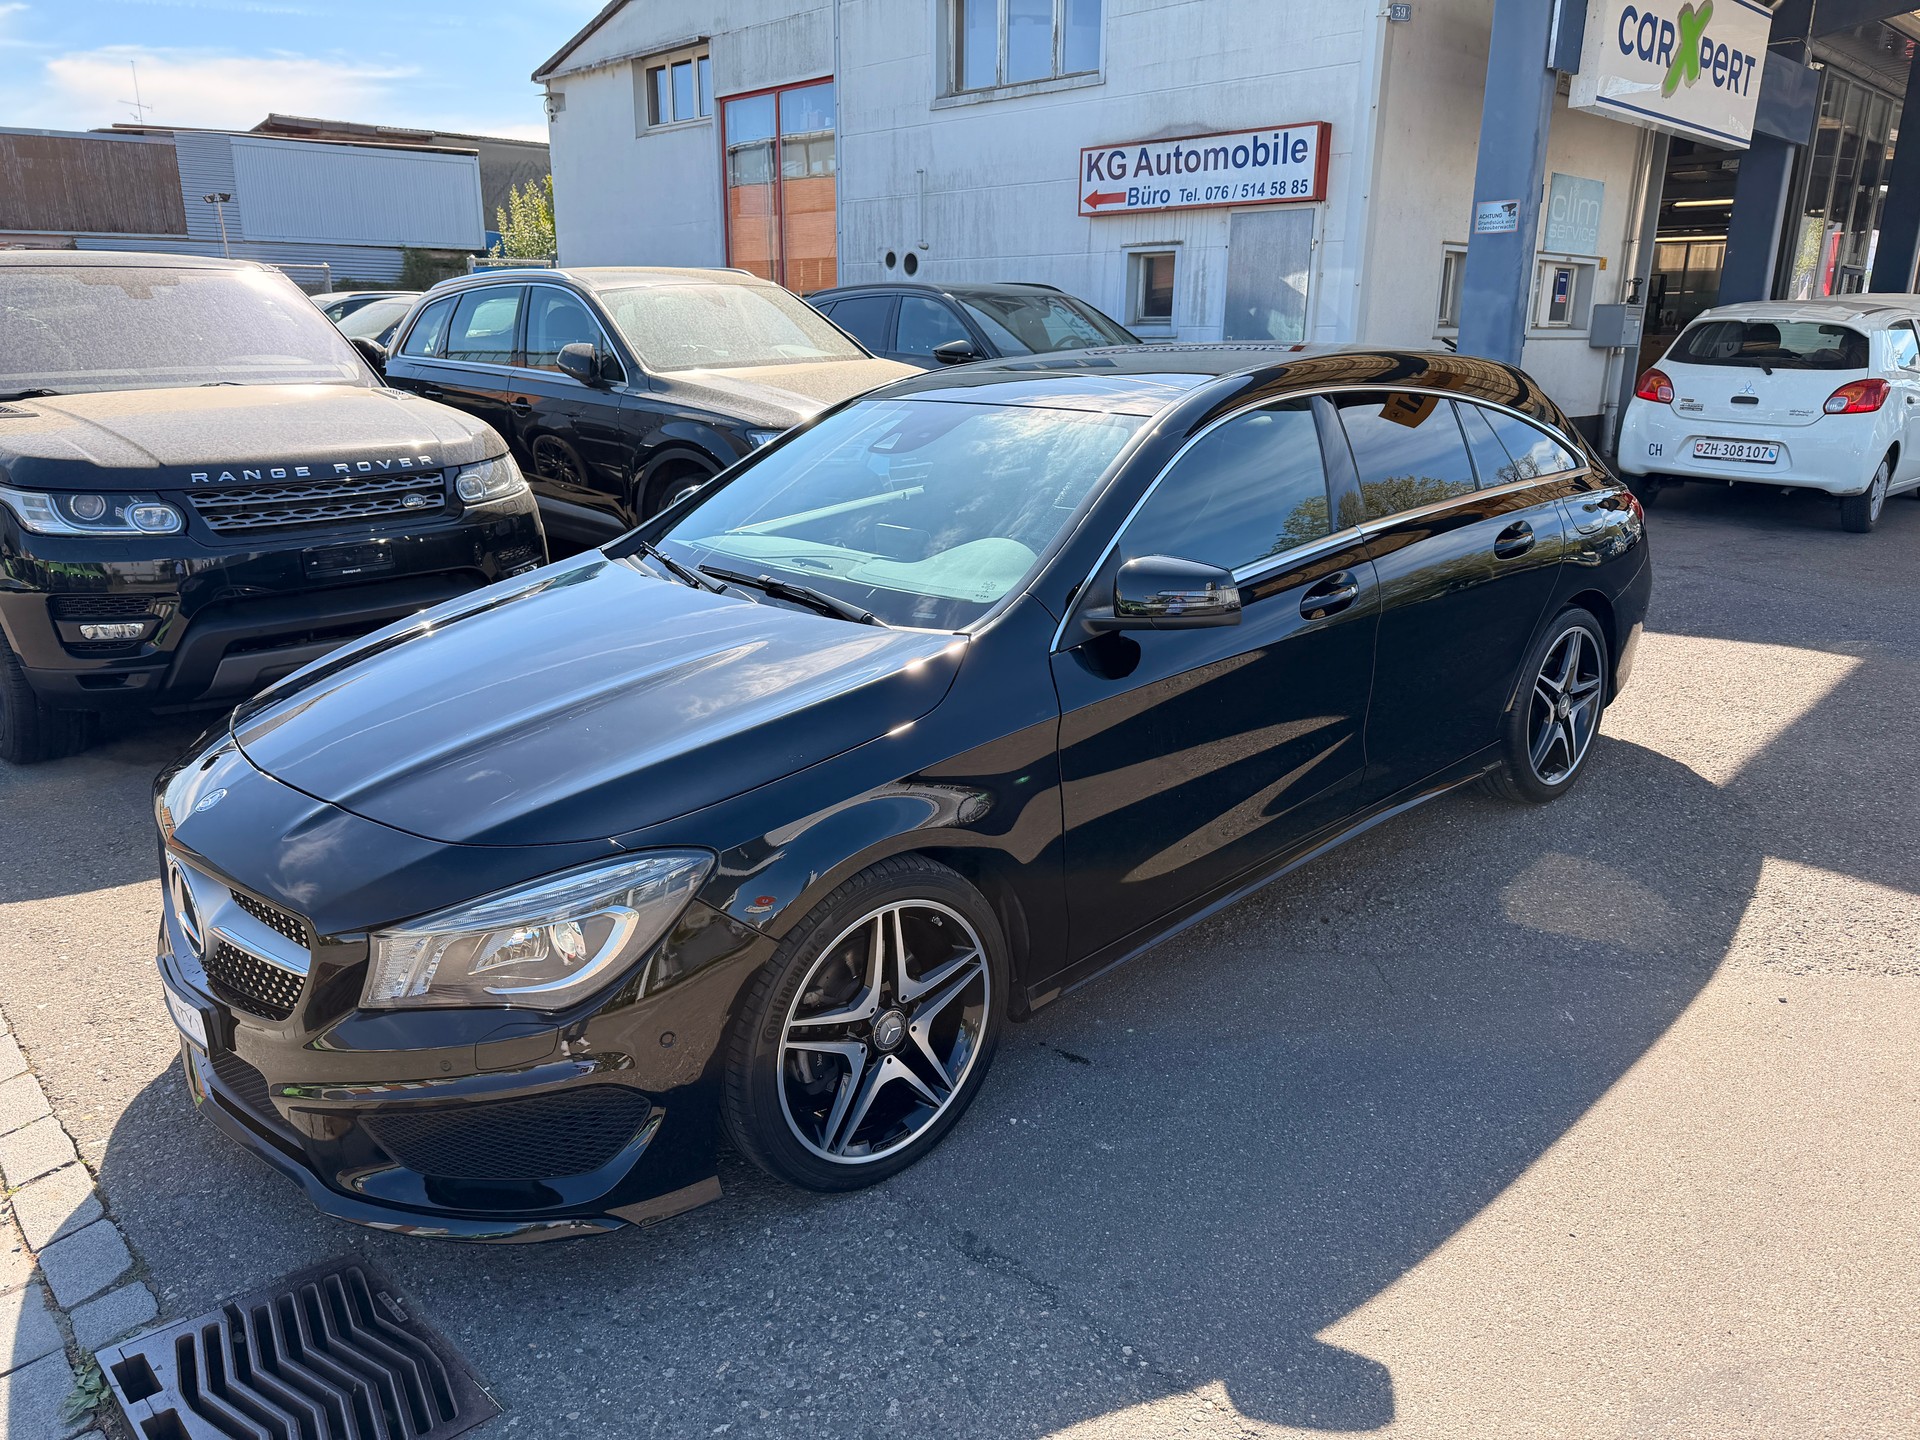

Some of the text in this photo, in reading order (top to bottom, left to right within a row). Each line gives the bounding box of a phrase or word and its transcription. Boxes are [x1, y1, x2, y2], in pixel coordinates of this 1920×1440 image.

[1086, 132, 1308, 182] KG Automobile
[1127, 186, 1171, 207] Büro
[1179, 187, 1201, 203] Tel.
[1205, 184, 1229, 201] 076
[1241, 182, 1265, 198] 514
[1269, 180, 1287, 196] 58
[1291, 178, 1308, 195] 85
[1551, 185, 1599, 226] clim
[1548, 223, 1597, 242] service
[1648, 442, 1663, 457] CH
[190, 455, 435, 484] RANGE ROVER
